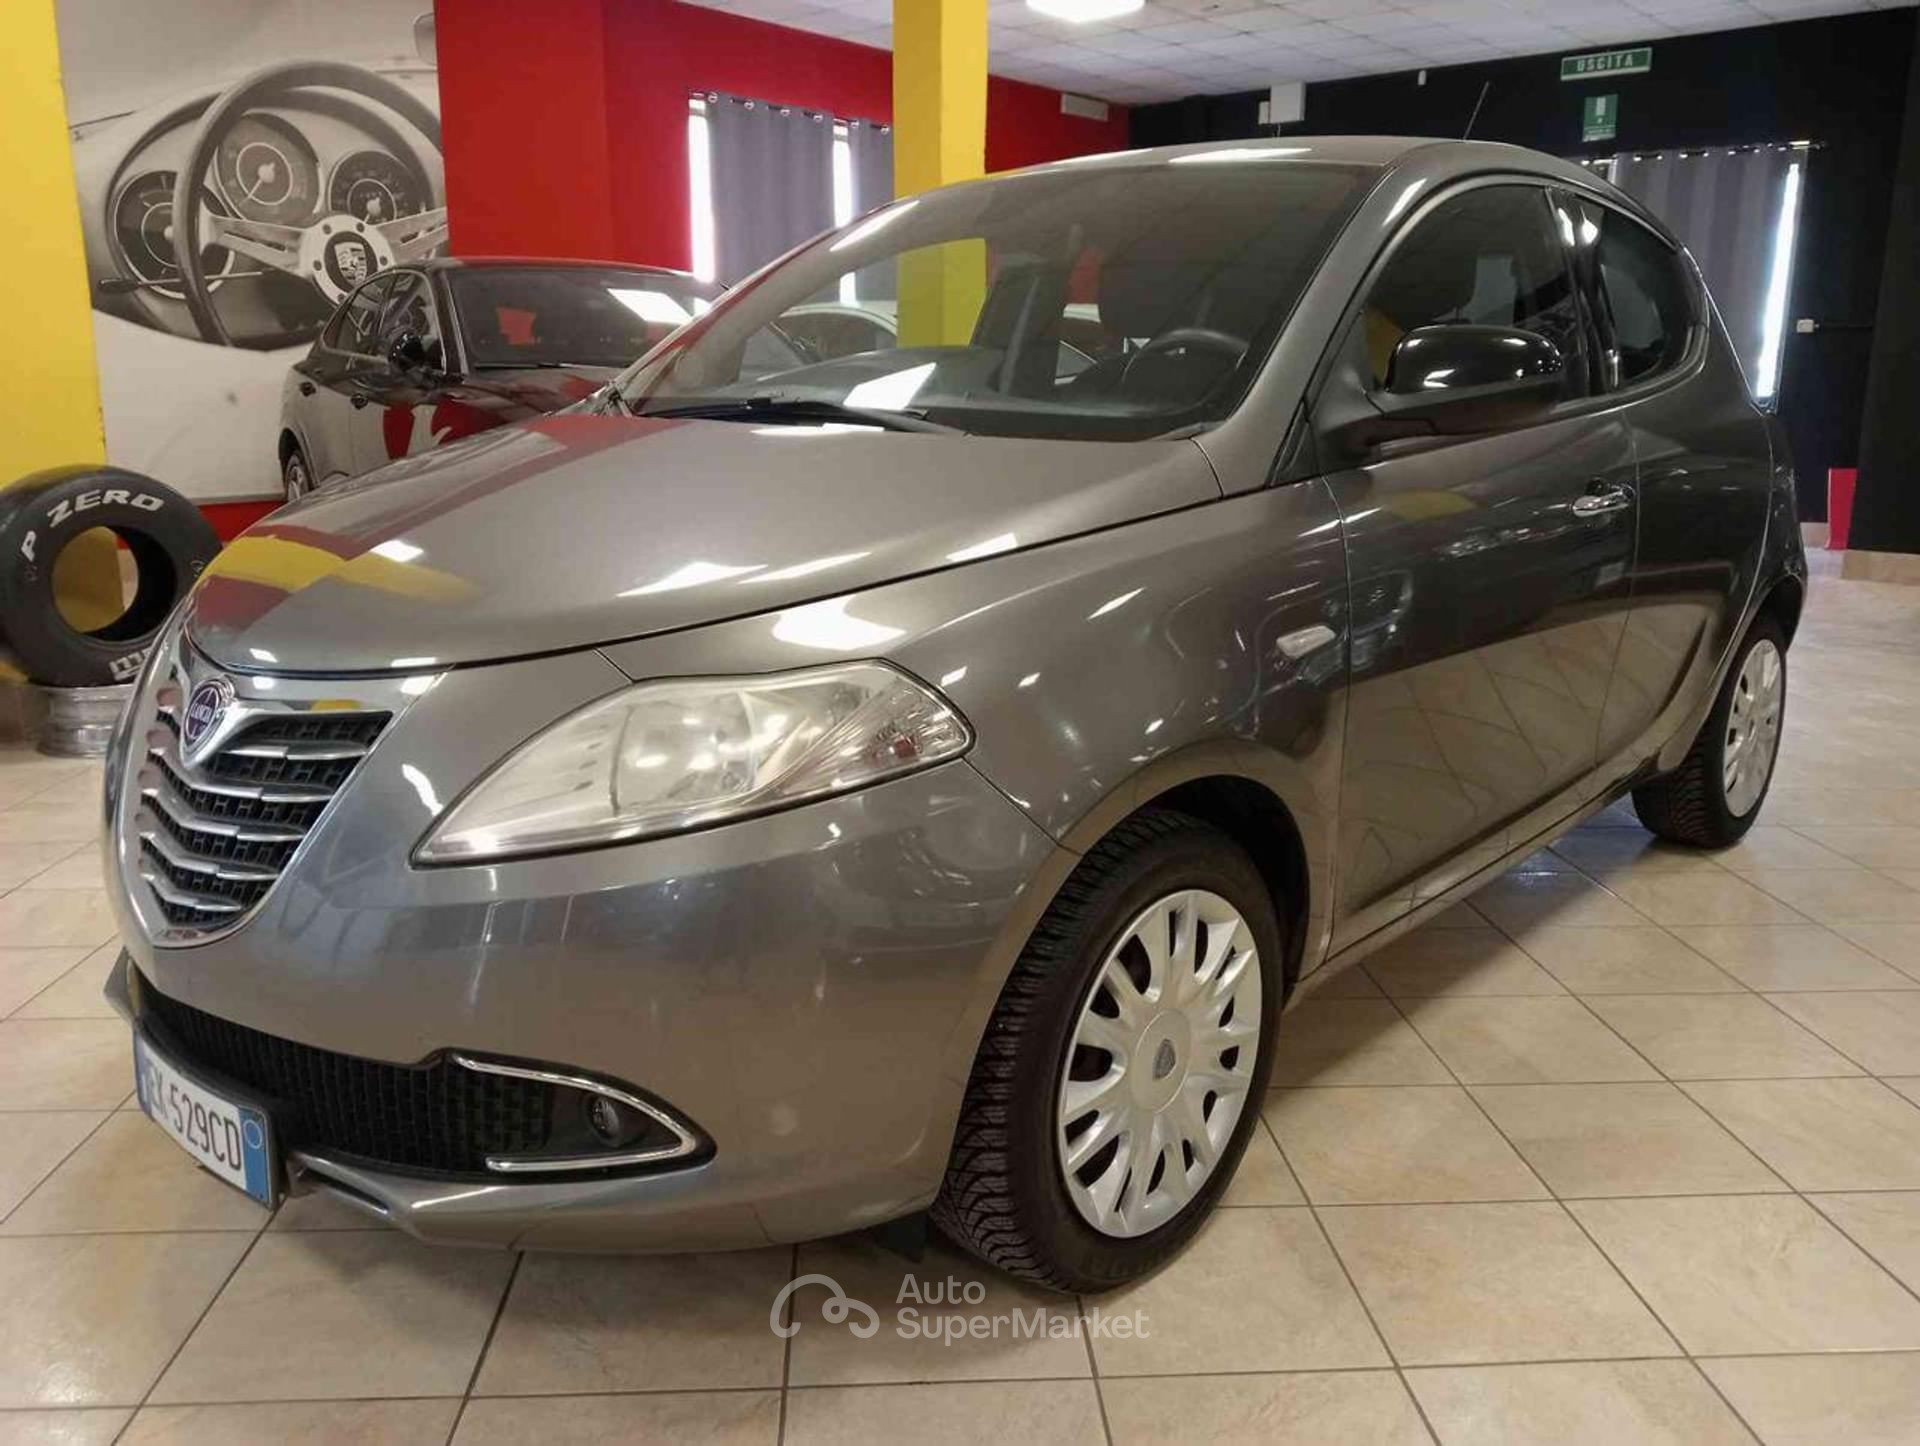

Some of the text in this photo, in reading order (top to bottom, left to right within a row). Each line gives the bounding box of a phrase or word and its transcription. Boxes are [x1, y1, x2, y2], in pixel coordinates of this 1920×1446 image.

[1577, 54, 1633, 72] USCITA
[21, 489, 165, 562] P ZERO
[171, 1083, 242, 1171] 529CD
